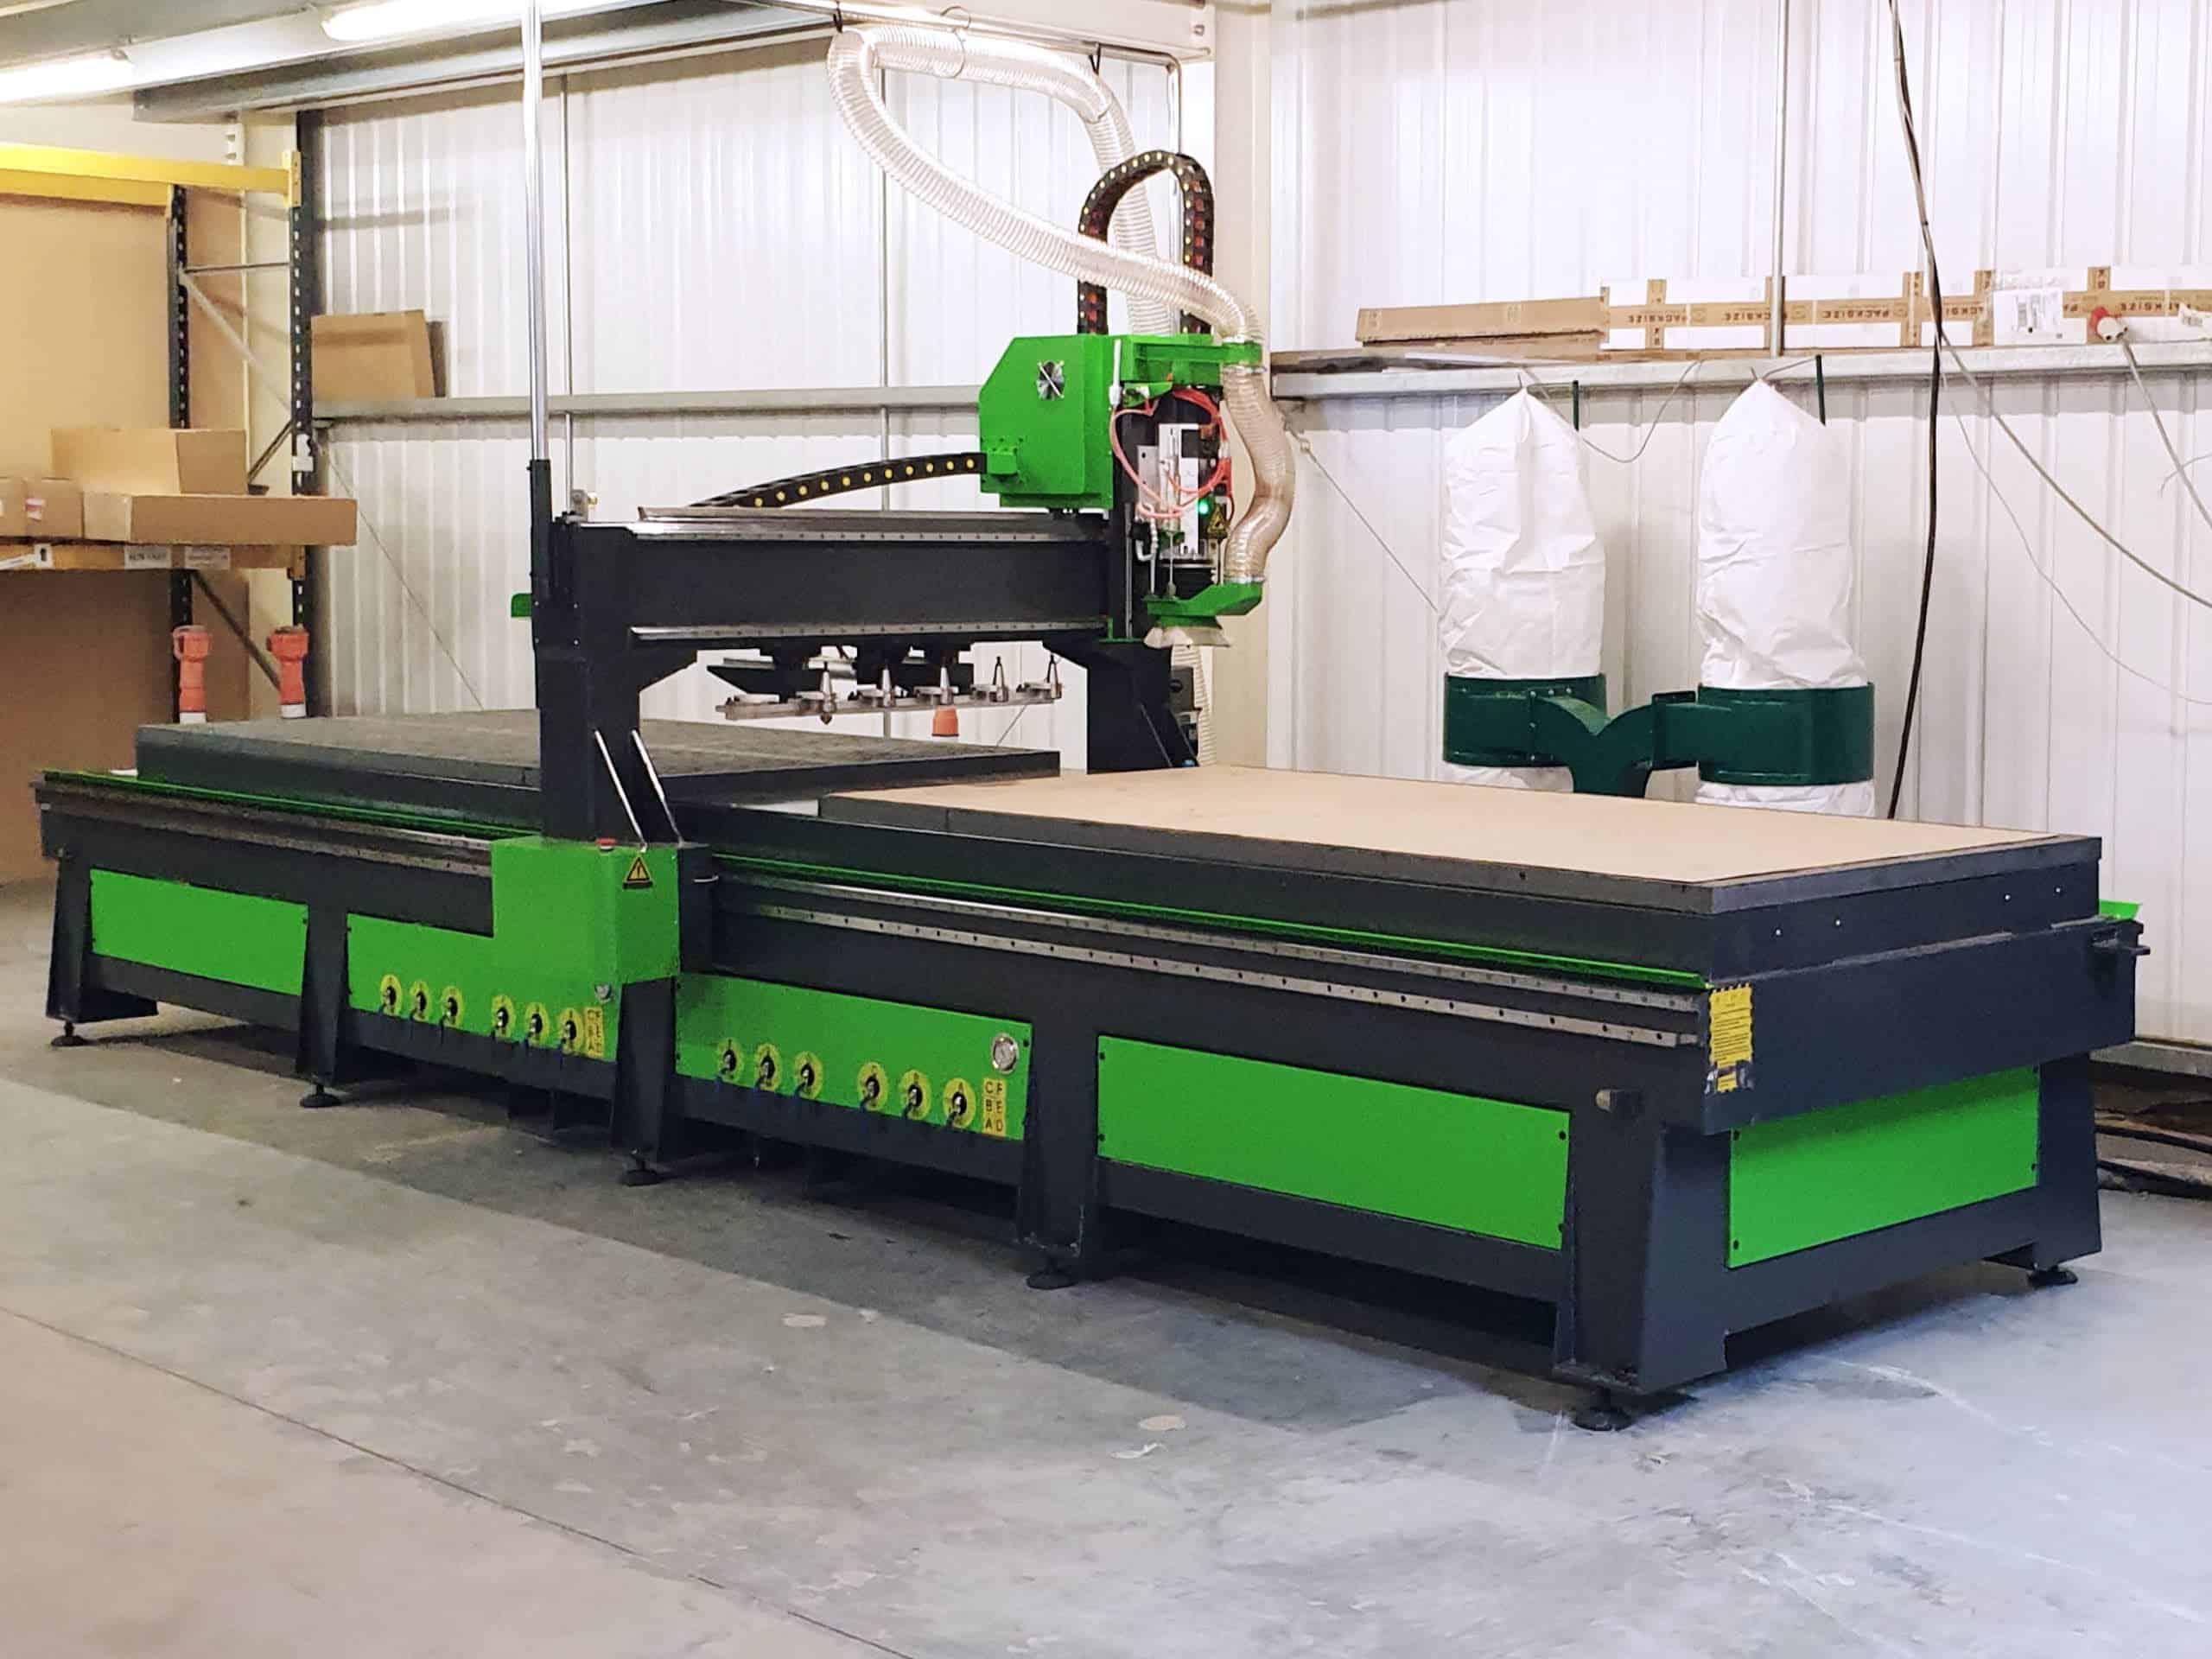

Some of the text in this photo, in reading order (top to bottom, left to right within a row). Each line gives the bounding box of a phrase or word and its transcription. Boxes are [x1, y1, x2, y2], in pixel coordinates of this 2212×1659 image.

[985, 1082, 994, 1094] C
[996, 1102, 1003, 1114] E
[985, 1118, 993, 1129] A
